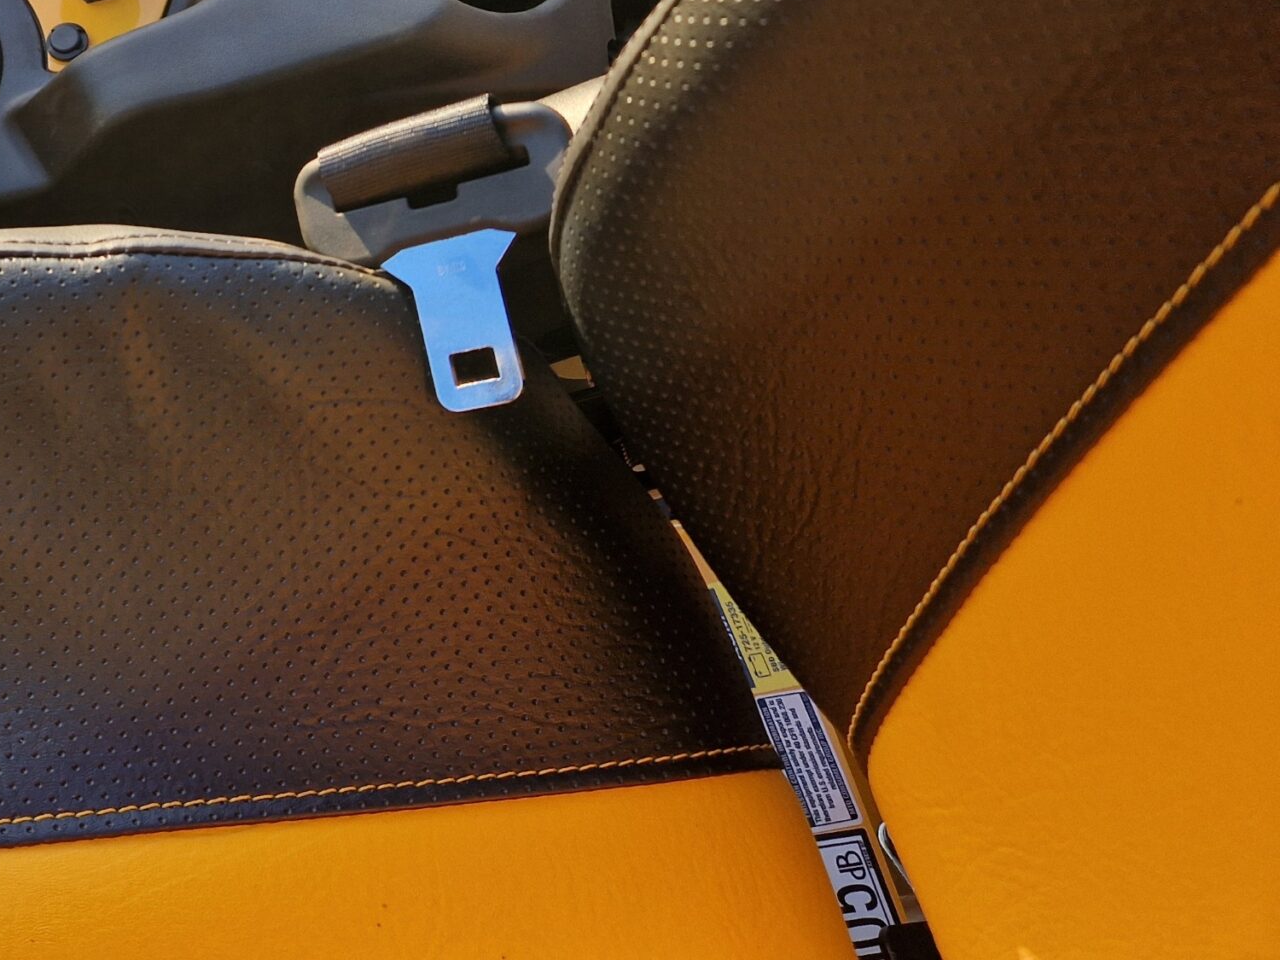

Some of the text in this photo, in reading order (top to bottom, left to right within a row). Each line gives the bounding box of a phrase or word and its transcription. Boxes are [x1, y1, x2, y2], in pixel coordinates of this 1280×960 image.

[725, 601, 752, 652] 725-17335
[798, 775, 816, 808] equipment
[813, 809, 821, 823] This
[836, 850, 866, 880] dB
